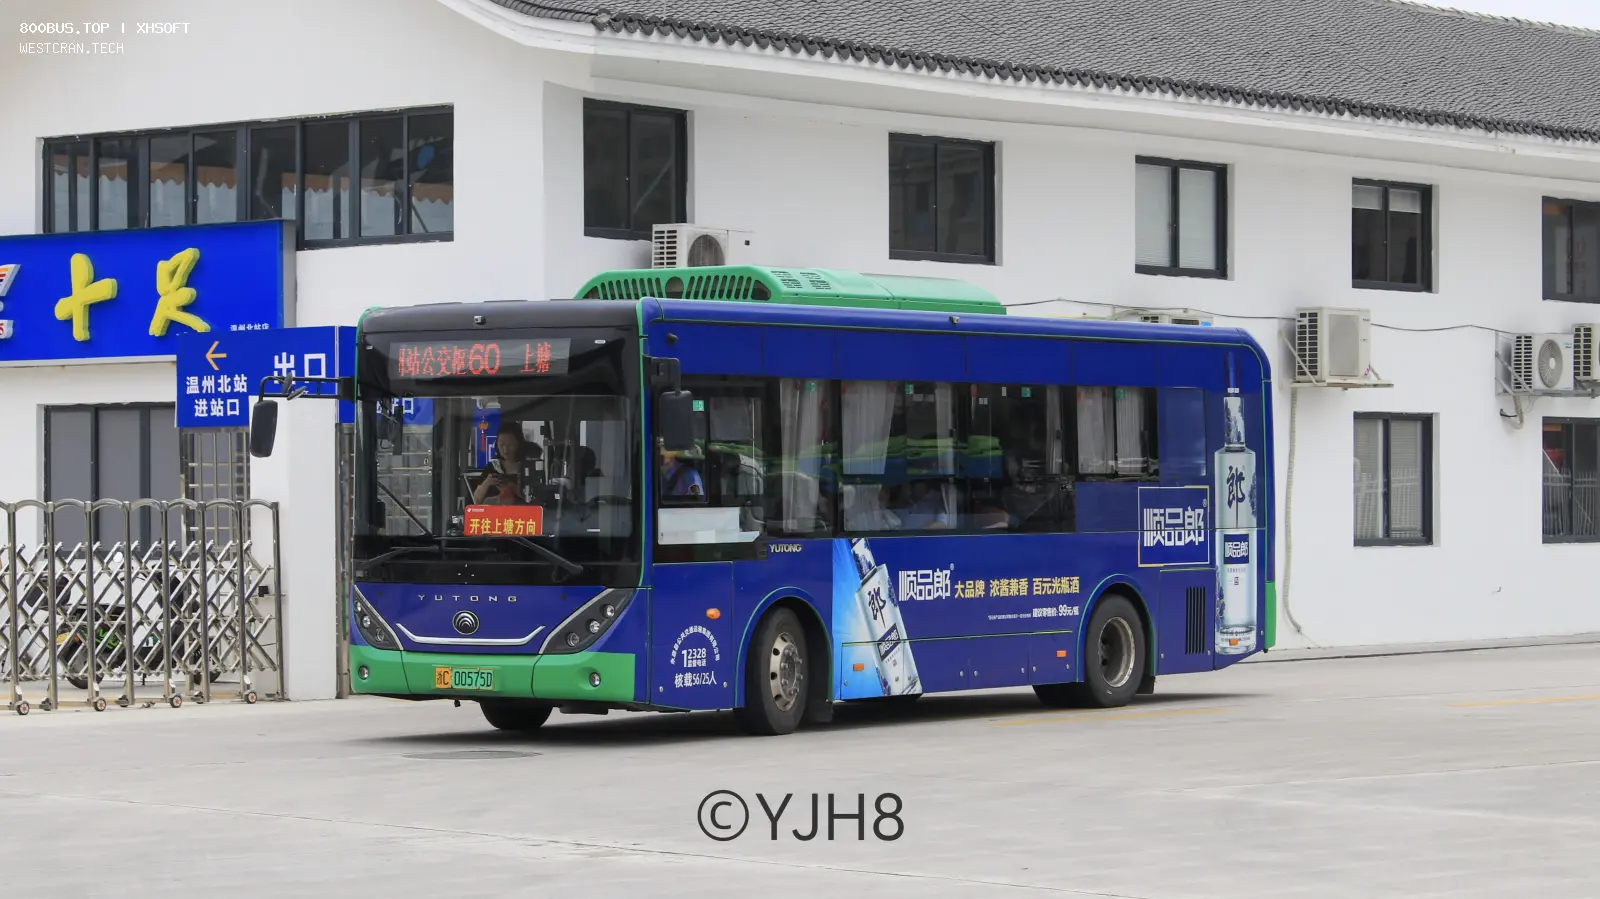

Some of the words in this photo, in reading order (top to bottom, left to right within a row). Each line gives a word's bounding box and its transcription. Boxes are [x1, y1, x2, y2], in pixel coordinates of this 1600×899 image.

[55, 248, 211, 341] 十足
[273, 351, 327, 385] 出口
[186, 374, 248, 395] 温州北站
[194, 398, 240, 417] 进站口
[469, 517, 537, 536] 开往上塘方向
[1143, 505, 1205, 547] 顺品郎
[769, 543, 802, 553] YUTONG
[1224, 540, 1249, 558] 顺品郎
[898, 568, 951, 602] 顺品郎
[954, 580, 986, 599] 大品牌
[989, 578, 1028, 597] 浓酱兼香
[1032, 576, 1080, 596] 百元光瓶酒
[418, 594, 517, 602] YUTONG
[674, 671, 717, 689] 核载56/25人
